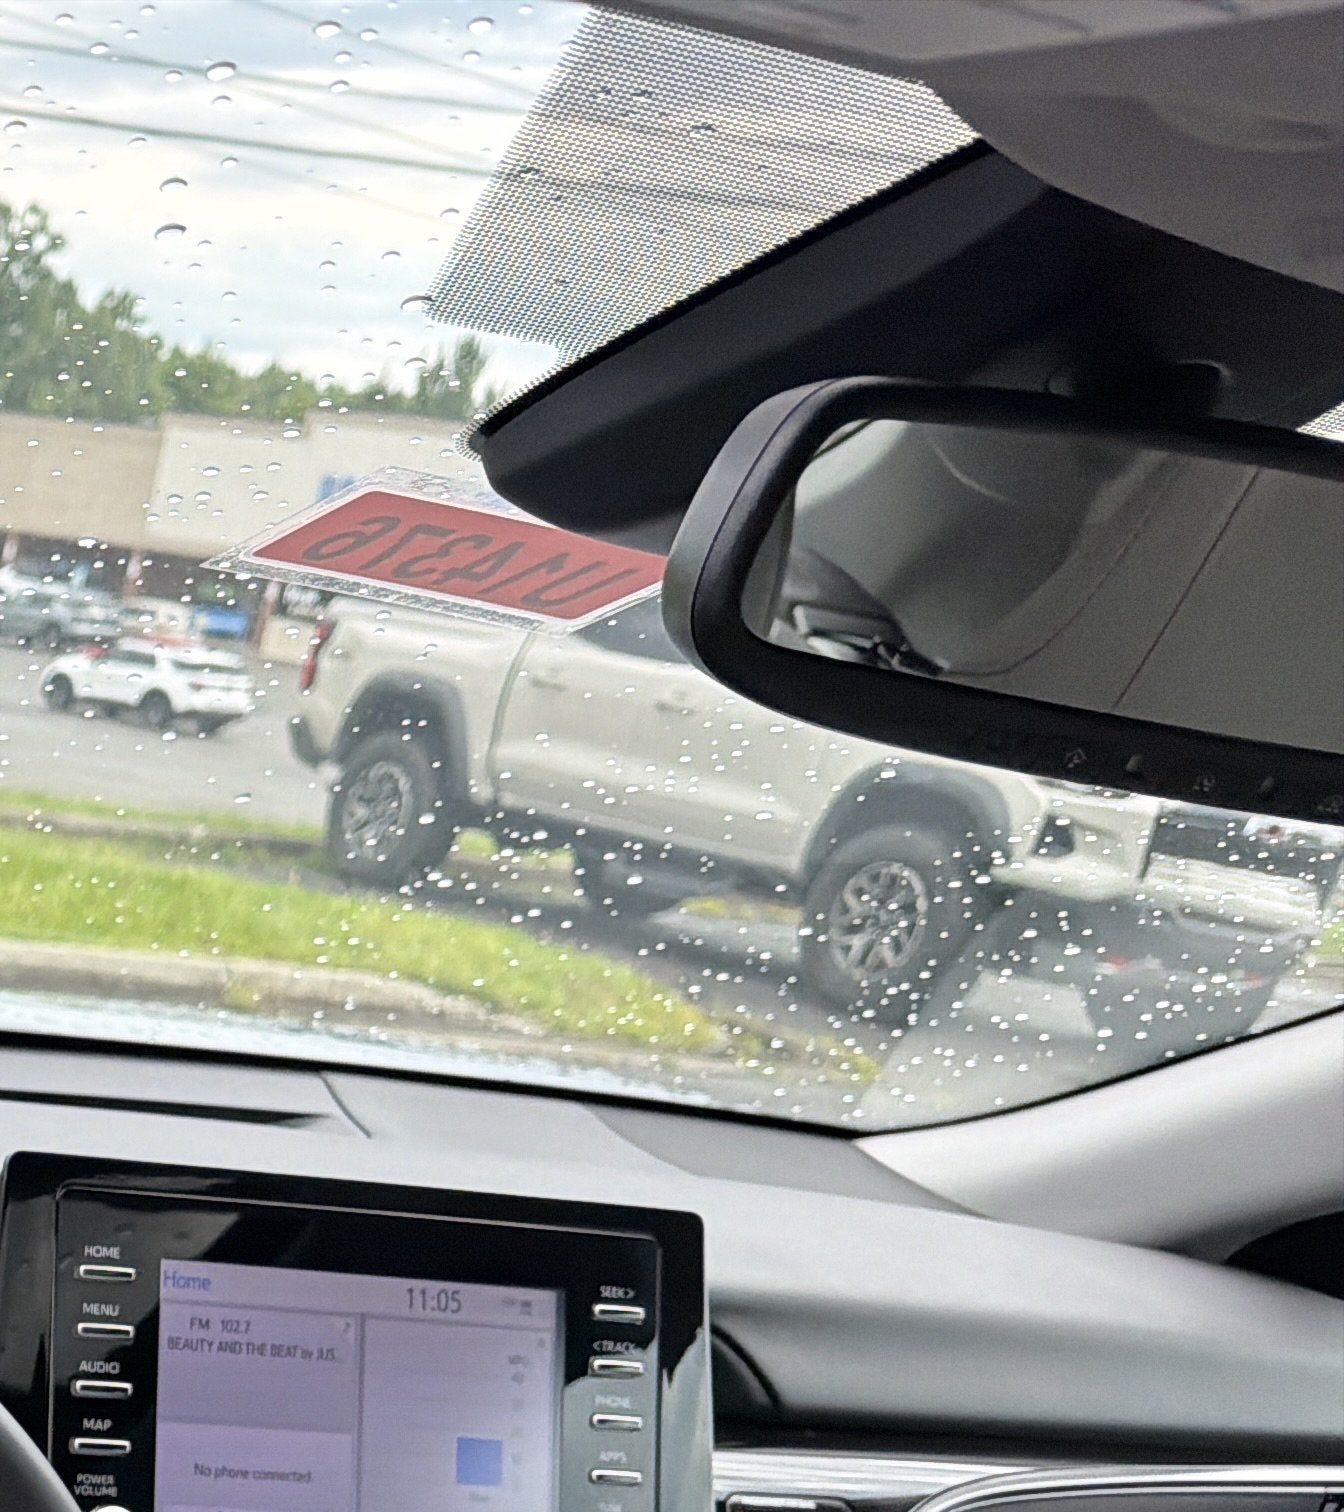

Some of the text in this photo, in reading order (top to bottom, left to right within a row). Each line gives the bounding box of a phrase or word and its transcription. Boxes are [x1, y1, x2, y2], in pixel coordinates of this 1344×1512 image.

[84, 1245, 120, 1259] HOME
[163, 1270, 212, 1291] Home
[406, 1287, 462, 1314] 11:05
[82, 1302, 119, 1316] MENU
[190, 1316, 252, 1334] FM 102.7
[167, 1336, 213, 1352] BEAUTY
[217, 1340, 243, 1356] AND
[245, 1342, 267, 1357] THE
[270, 1344, 299, 1360] BEAT
[79, 1360, 120, 1374] AUDIO
[82, 1418, 112, 1431] MAP
[193, 1463, 211, 1477] No
[214, 1465, 249, 1480] phone
[76, 1473, 114, 1485] POWER
[74, 1485, 118, 1497] VOLUME
